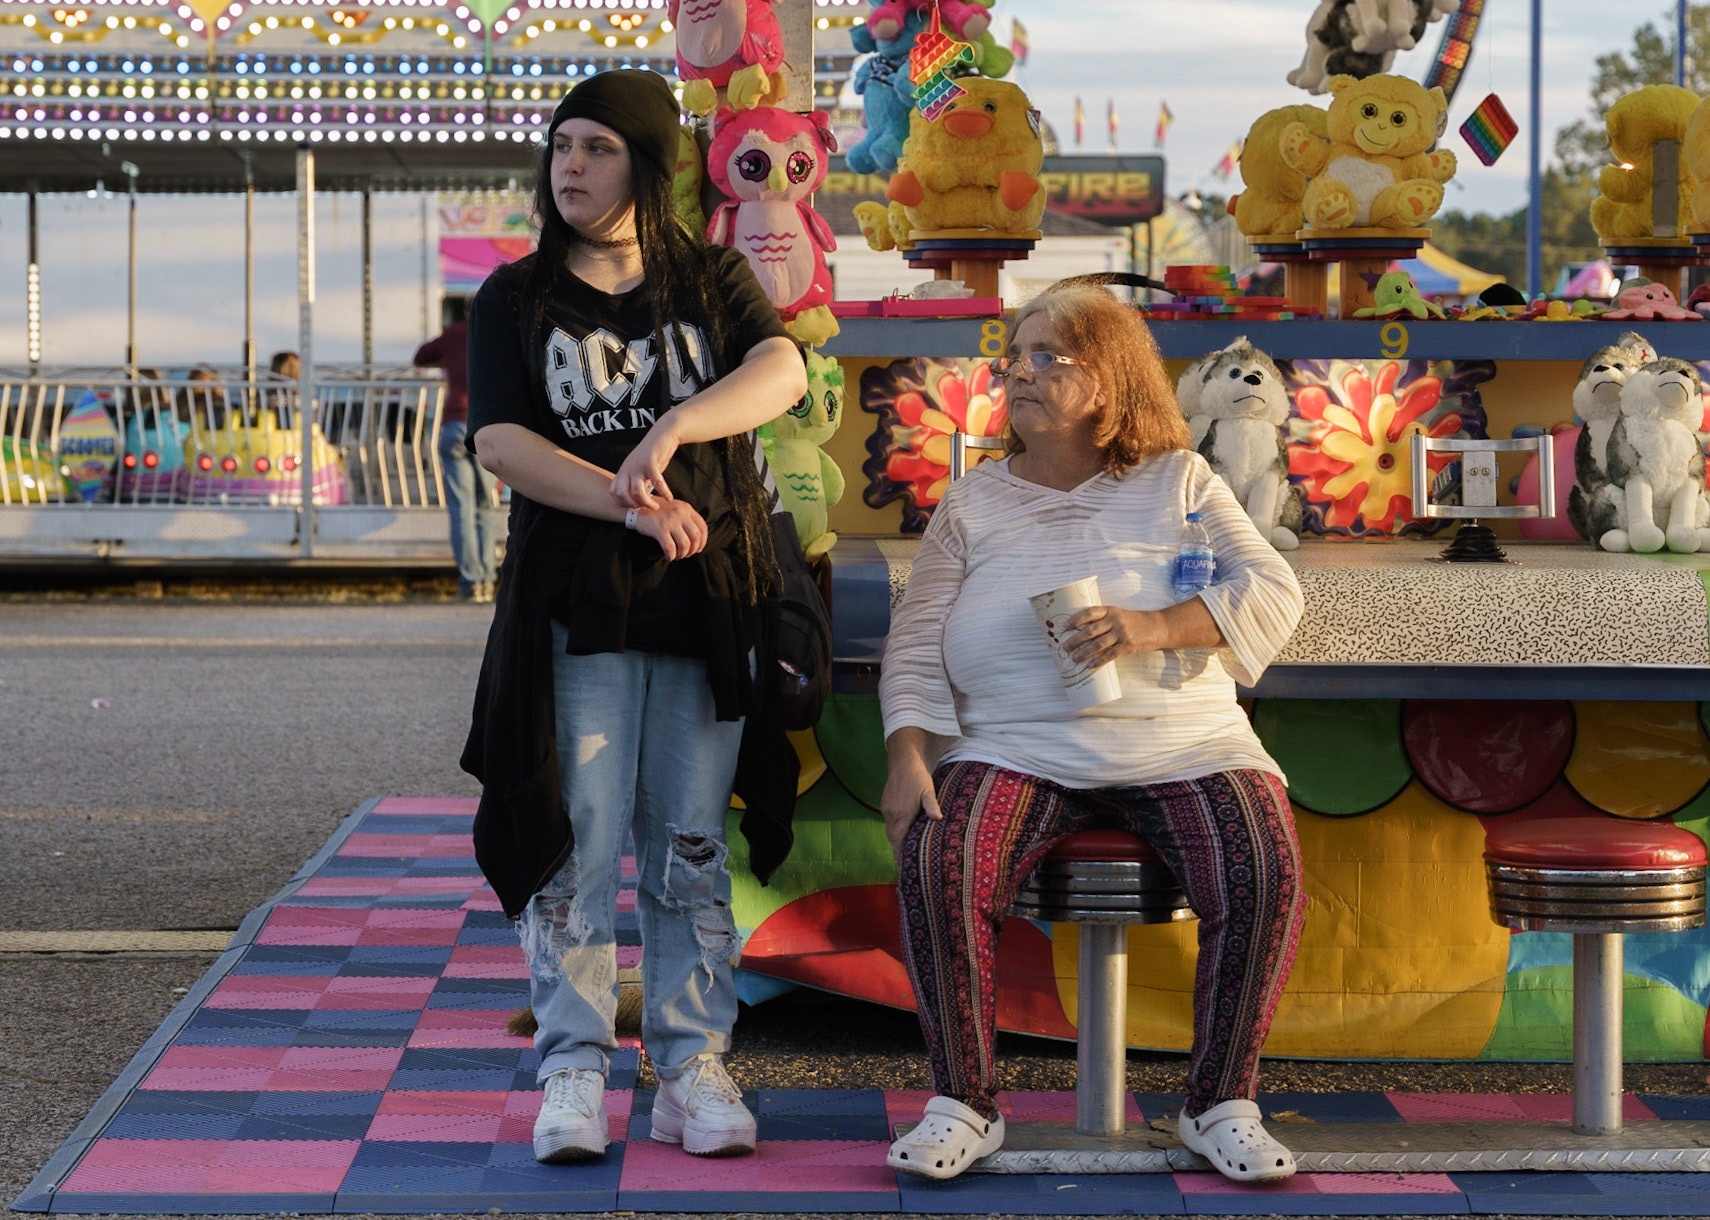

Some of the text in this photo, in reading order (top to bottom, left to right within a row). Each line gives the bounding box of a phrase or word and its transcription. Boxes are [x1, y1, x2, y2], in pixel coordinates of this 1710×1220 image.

[821, 171, 1150, 198] RIN FIRE
[979, 319, 1007, 357] 8
[1380, 322, 1409, 359] 9
[560, 407, 656, 439] BACK IN
